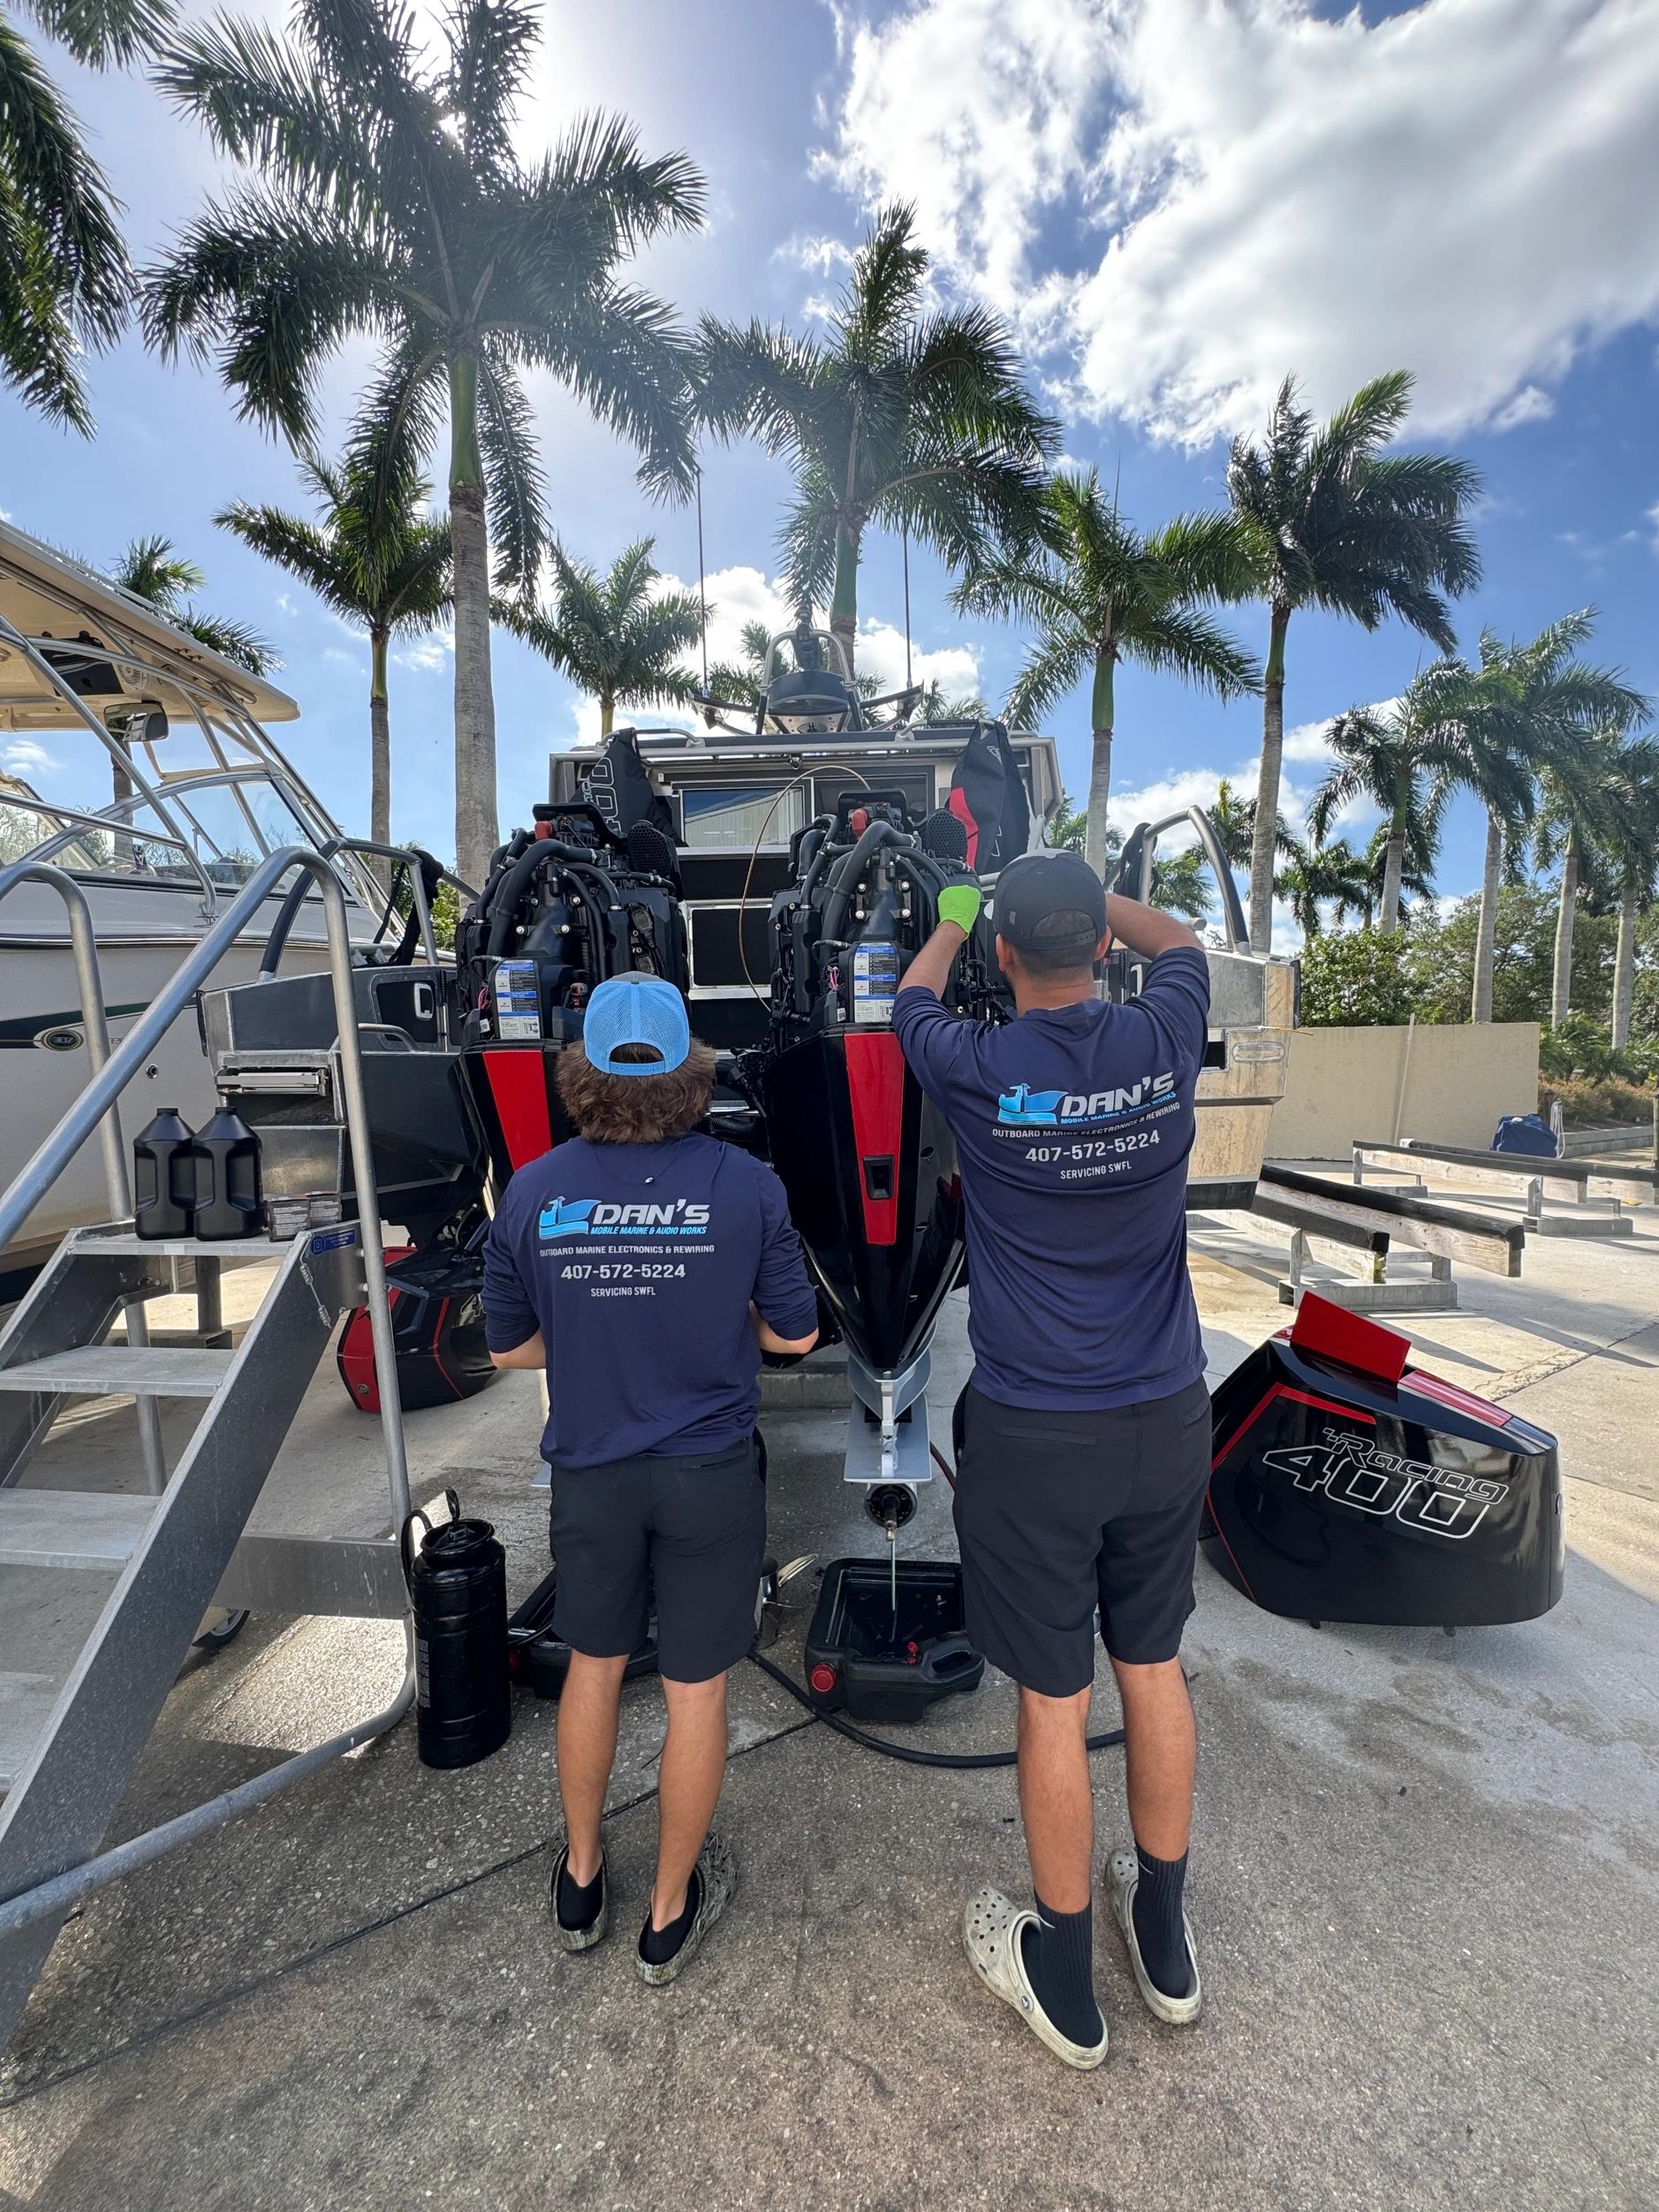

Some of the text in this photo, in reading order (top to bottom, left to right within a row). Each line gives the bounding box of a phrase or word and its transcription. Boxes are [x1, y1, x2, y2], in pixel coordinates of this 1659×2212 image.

[1060, 1071, 1175, 1117] DAN'S
[1090, 1112, 1120, 1121] MARINE
[1151, 1091, 1177, 1106] WORKS
[992, 1128, 1041, 1138] OUTBOARD
[1146, 1102, 1181, 1121] REWIRING
[1025, 1129, 1161, 1163] 407-572-5224
[1060, 1161, 1133, 1179] SERVICING SWFL
[592, 1199, 710, 1225] DAN'S
[590, 1226, 707, 1235] MOBILE MARINE & AUDIO WORKS
[540, 1246, 574, 1257] OUTBOARD
[575, 1246, 607, 1254] MARINE
[673, 1245, 715, 1254] REWIRING
[561, 1263, 686, 1280] 407-572-5224
[590, 1286, 656, 1298] SERVICING SWFL
[1331, 1431, 1510, 1505] Racing
[1261, 1444, 1490, 1540] 400
